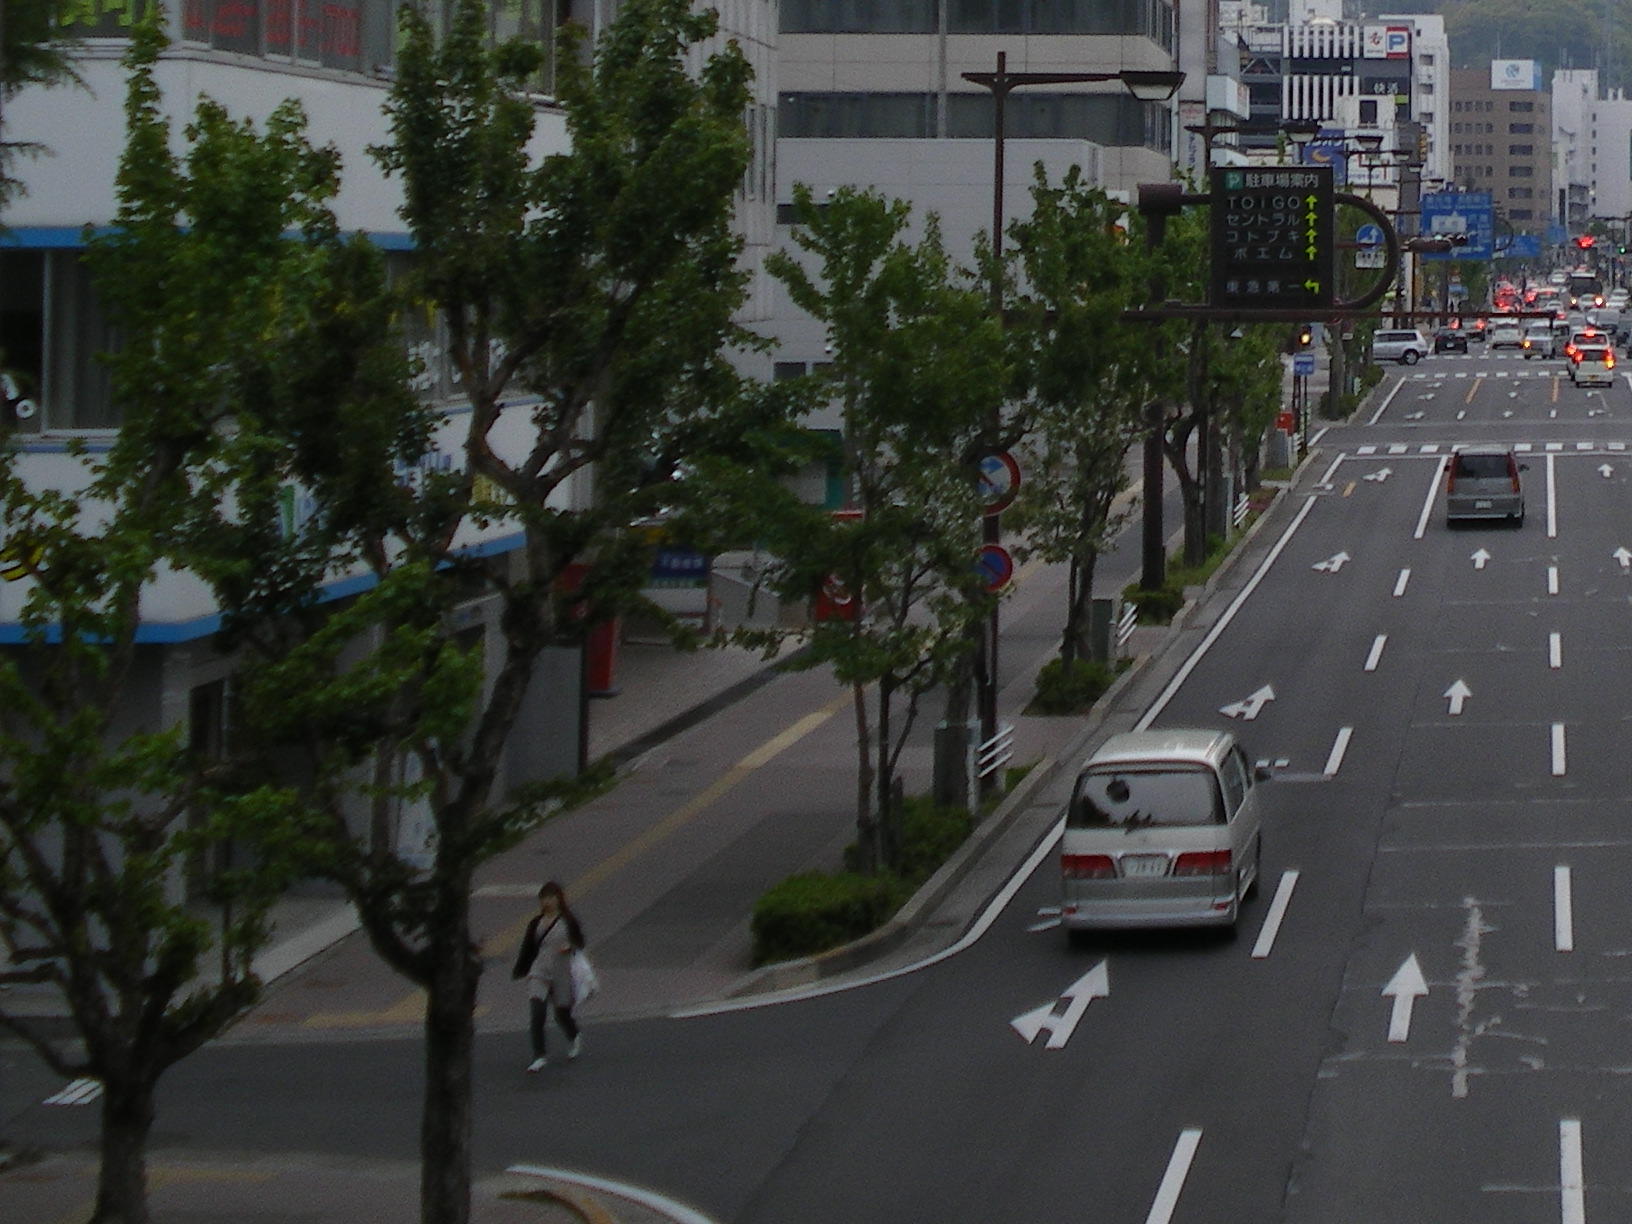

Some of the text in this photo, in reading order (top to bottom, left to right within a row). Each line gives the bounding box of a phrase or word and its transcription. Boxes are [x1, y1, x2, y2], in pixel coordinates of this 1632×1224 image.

[1389, 34, 1405, 51] P
[1245, 173, 1319, 188] 駐車場案内
[1226, 213, 1300, 226] セントラル
